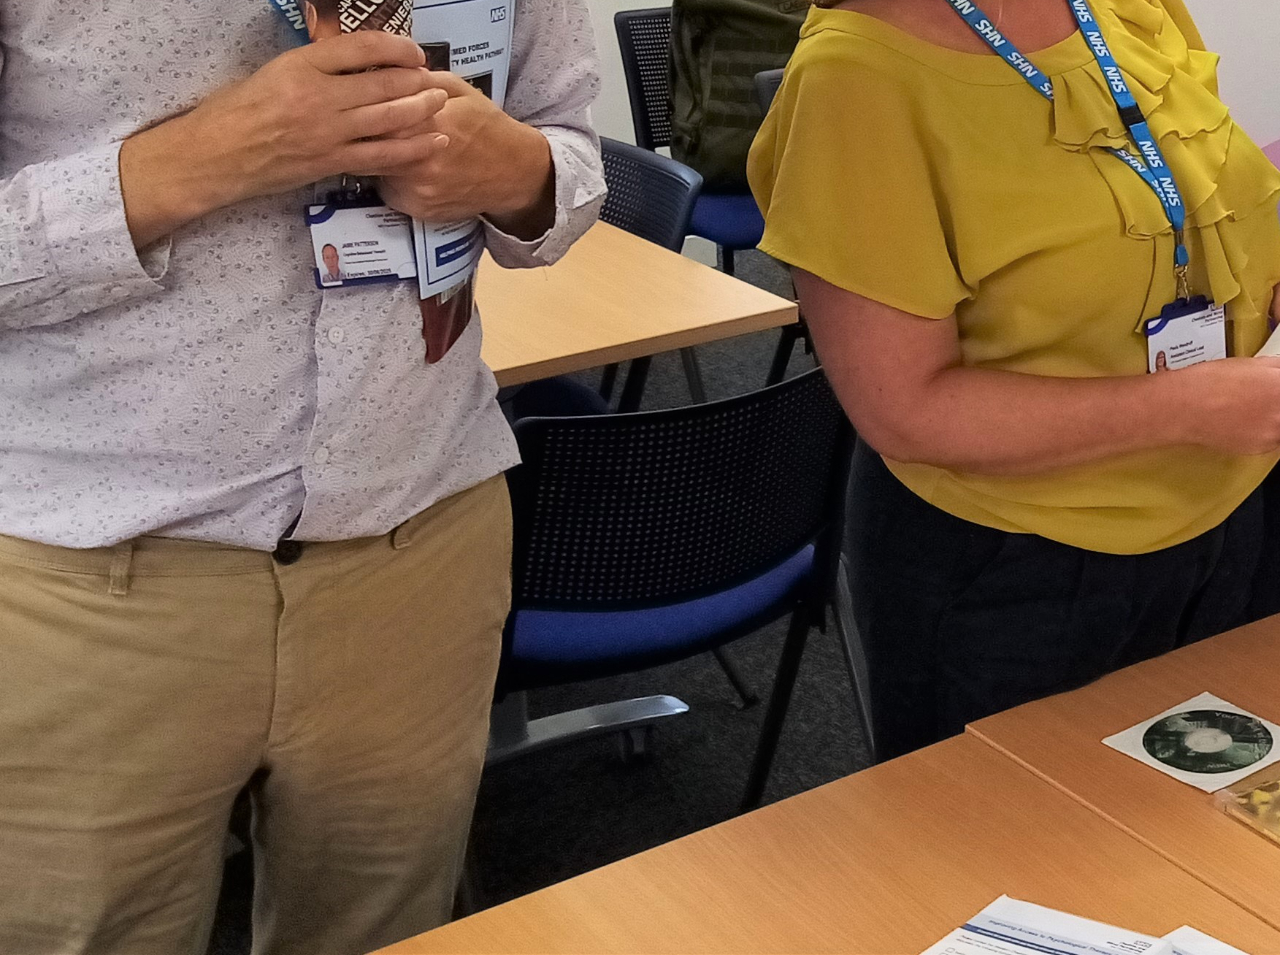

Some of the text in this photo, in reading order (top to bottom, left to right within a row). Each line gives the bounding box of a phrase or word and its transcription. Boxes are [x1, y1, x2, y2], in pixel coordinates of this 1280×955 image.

[490, 6, 506, 23] NHS
[974, 18, 1006, 47] NHS
[1087, 30, 1110, 58] NHS
[461, 54, 484, 65] HEALTH
[1007, 52, 1038, 78] NHS
[1104, 65, 1127, 93] NHS
[1138, 140, 1163, 168] NHS
[1159, 176, 1181, 207] NHS
